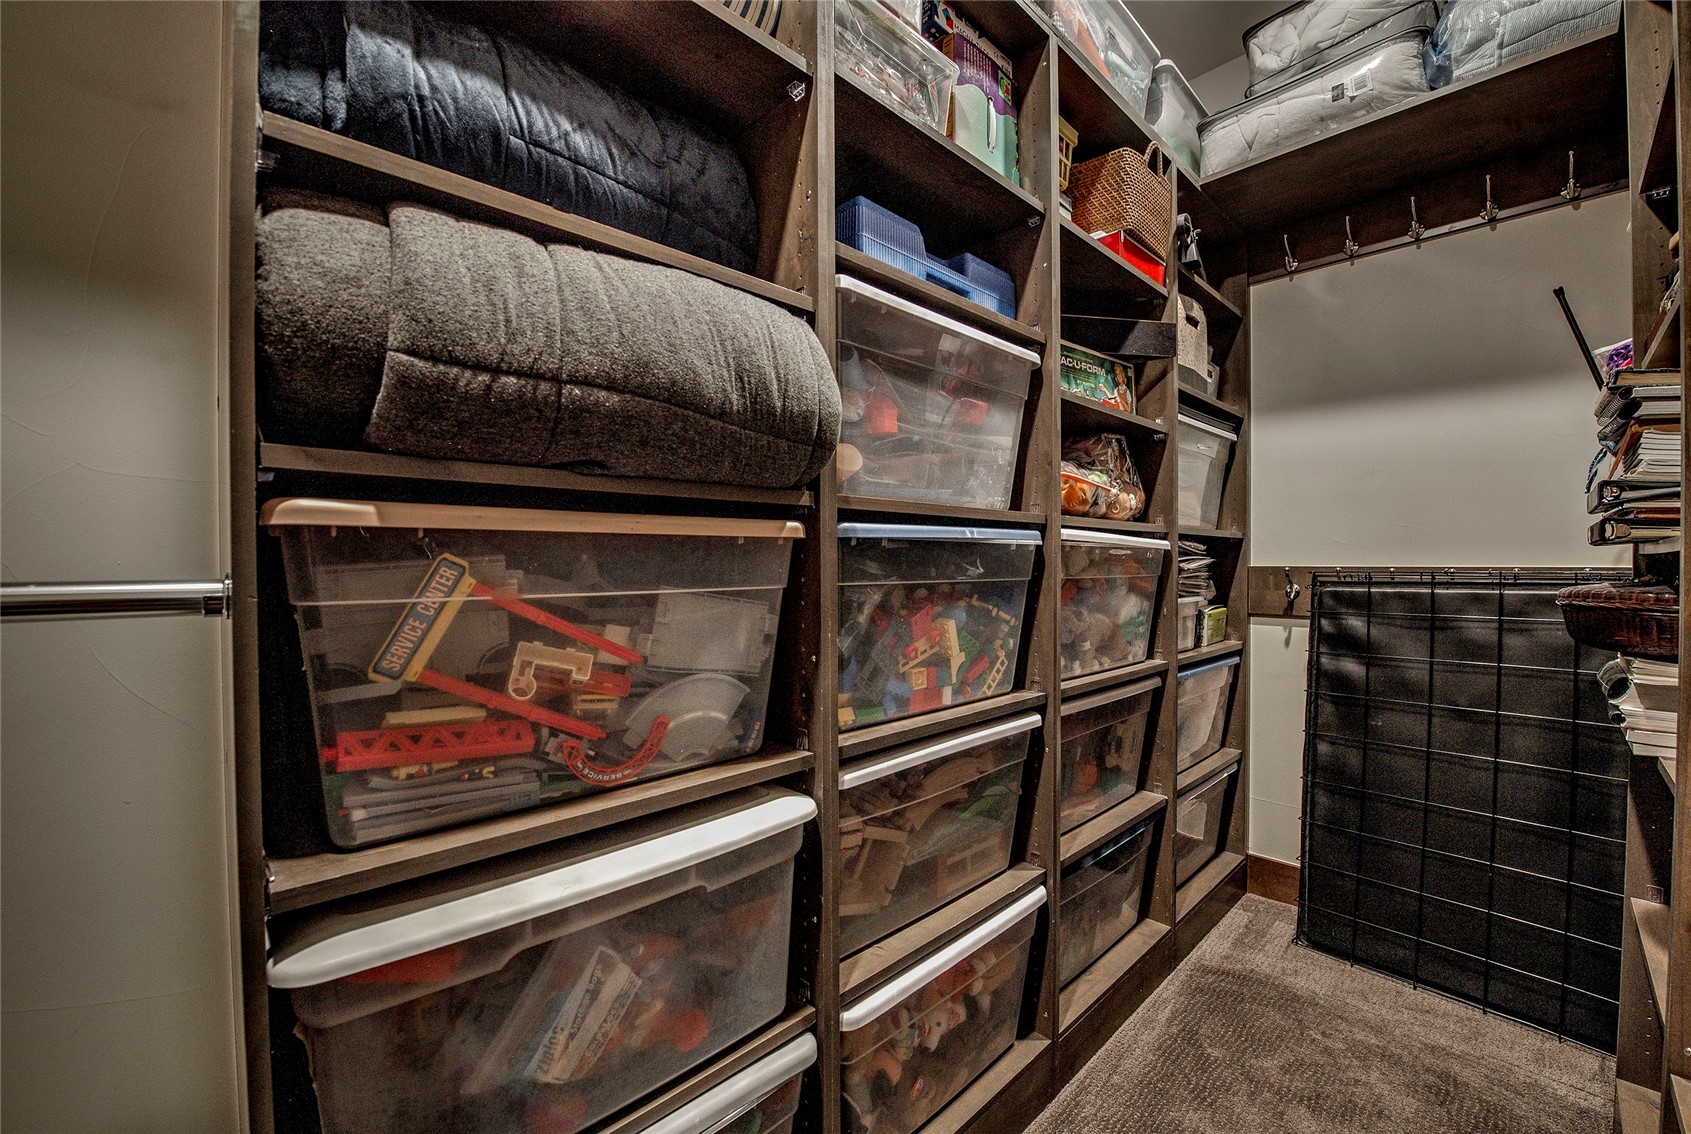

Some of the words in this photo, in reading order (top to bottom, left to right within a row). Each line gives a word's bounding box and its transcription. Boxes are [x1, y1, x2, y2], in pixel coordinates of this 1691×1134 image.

[1060, 355, 1106, 376] AC-U-FORM
[381, 618, 428, 671] SERVICE
[416, 566, 459, 616] CENTER
[582, 768, 623, 781] SERVICE
